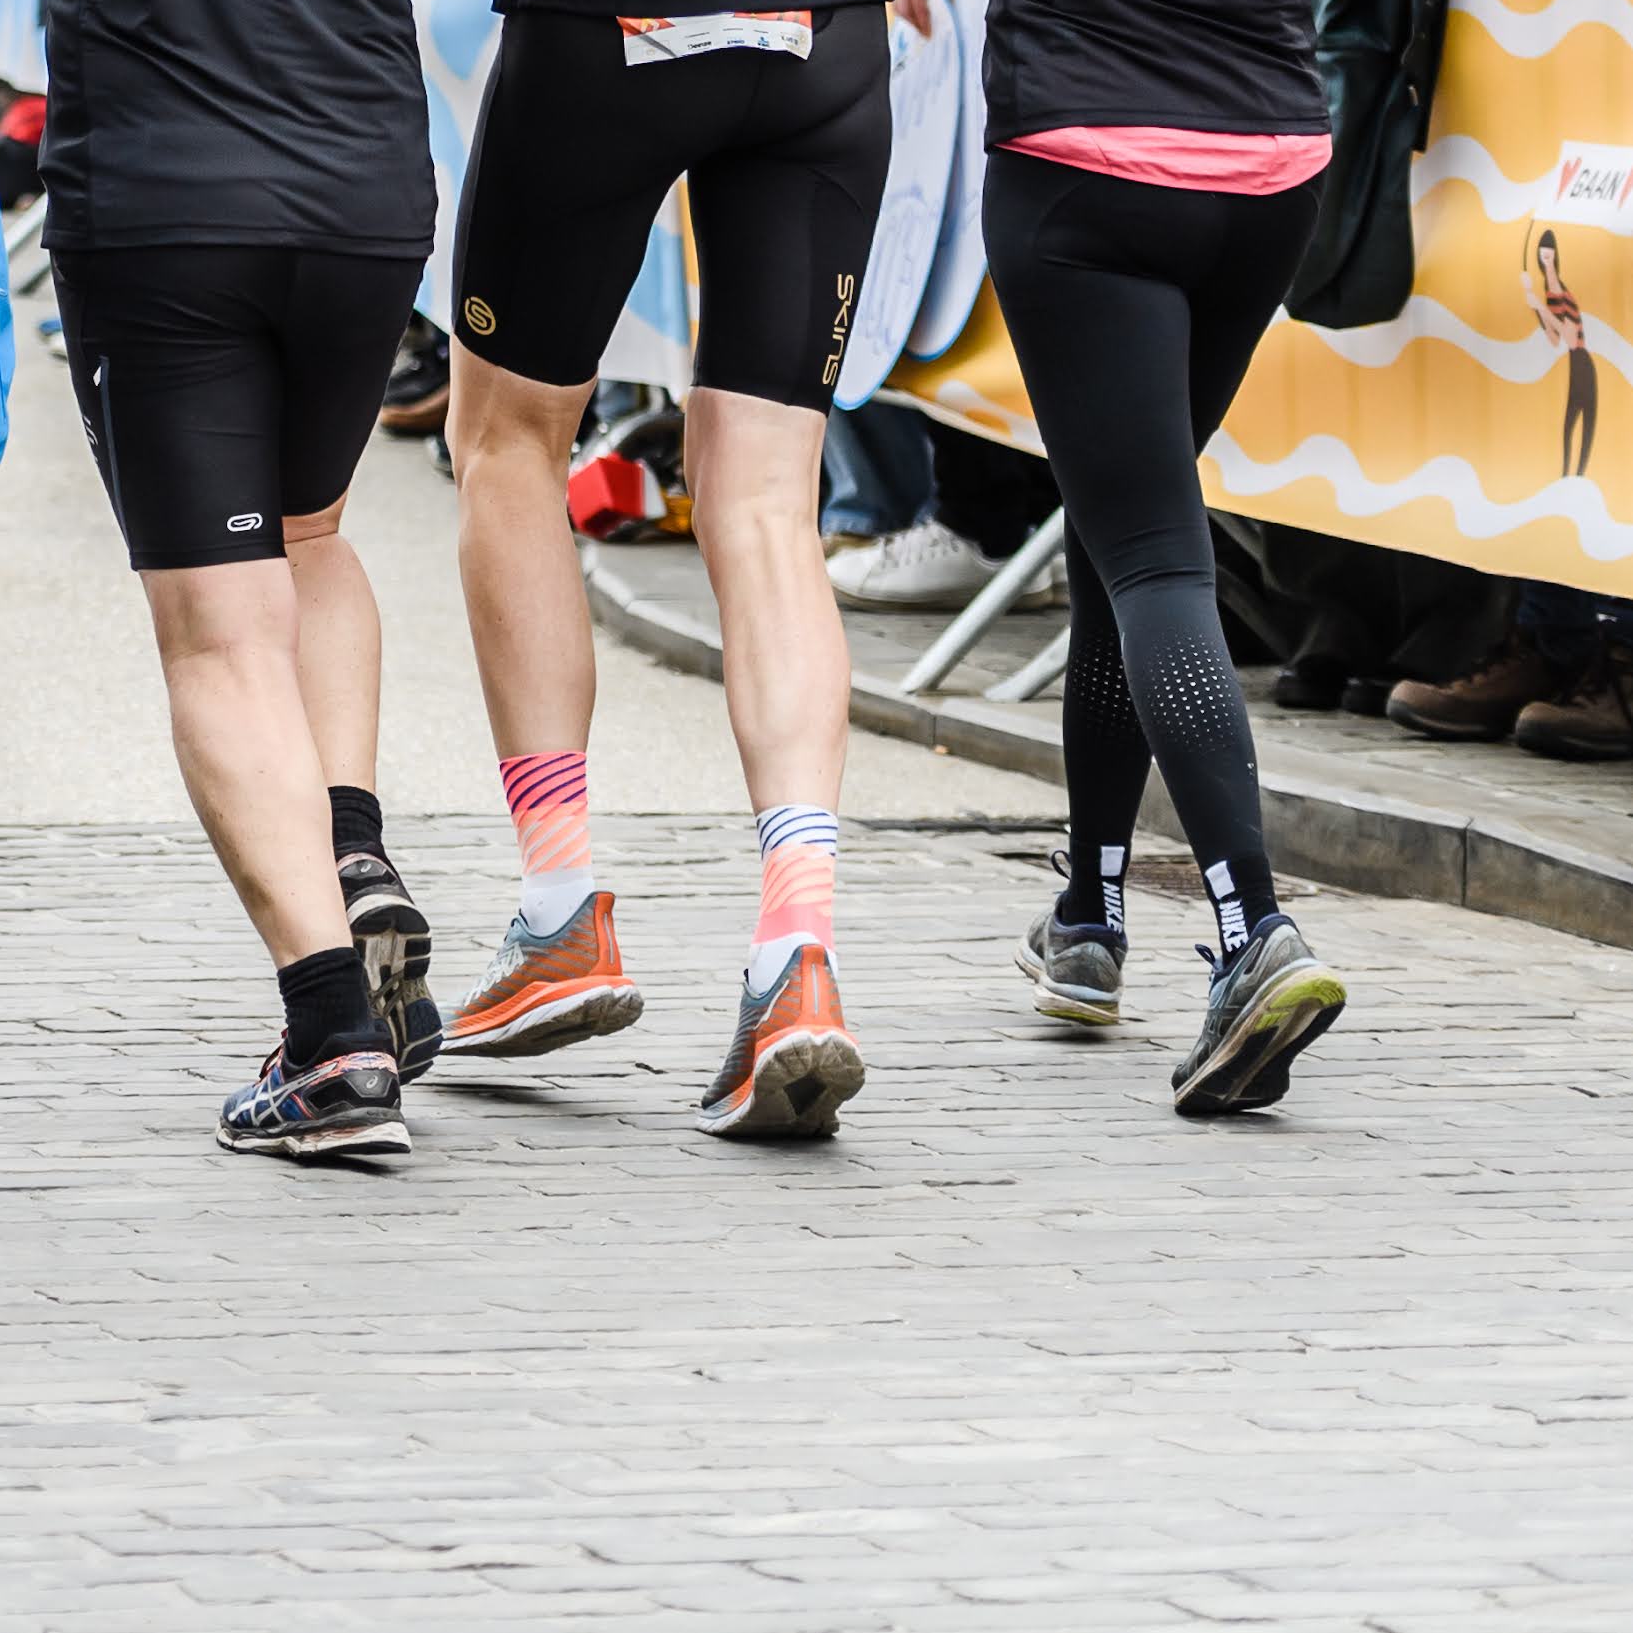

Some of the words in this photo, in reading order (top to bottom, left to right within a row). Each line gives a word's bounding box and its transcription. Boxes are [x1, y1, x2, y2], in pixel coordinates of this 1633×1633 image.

[1570, 168, 1626, 200] GAAN
[822, 273, 854, 386] SKINS
[1102, 881, 1124, 935] NIKE
[1219, 898, 1249, 953] NIKE
